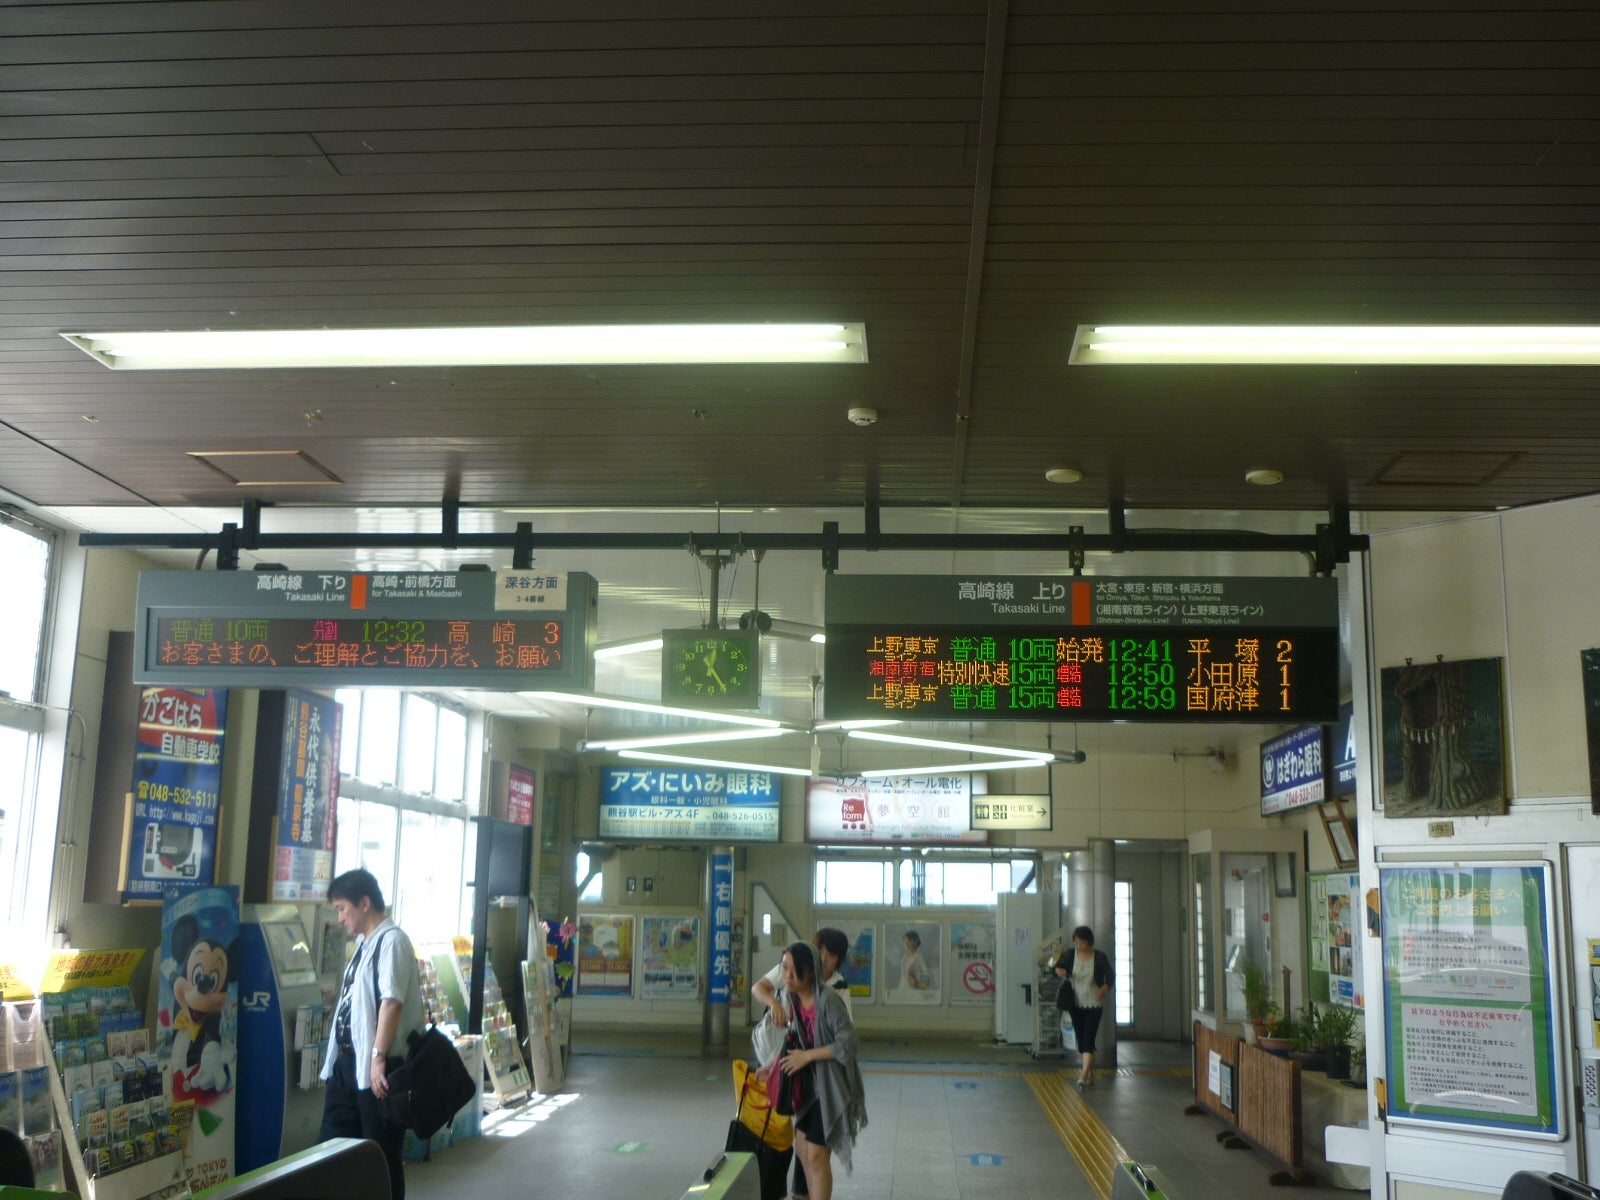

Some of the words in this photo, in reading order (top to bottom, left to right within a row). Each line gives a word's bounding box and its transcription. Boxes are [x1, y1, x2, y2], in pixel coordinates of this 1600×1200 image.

[257, 575, 302, 590] 高崎線
[318, 575, 346, 590] 下り
[372, 575, 456, 588] 高崎・前橋方面
[505, 576, 558, 589] 深谷方面
[1096, 583, 1224, 594] 大宮・東京・新宿・横浜方面
[285, 592, 324, 601] Takasaki
[326, 592, 345, 601] Line
[372, 590, 382, 598] for
[384, 590, 417, 598] Takasaki
[426, 590, 462, 598] Maebashi
[958, 582, 1014, 600] 高崎線
[1032, 582, 1066, 600] 上り
[991, 603, 1039, 614] Takasaki
[1043, 603, 1065, 614] Line
[171, 620, 214, 642] 普通
[225, 620, 269, 642] 10両
[362, 620, 425, 642] 12:32
[544, 622, 559, 644] 3
[162, 641, 277, 666] お客さまの、
[294, 642, 479, 667] ご理解とご協力を、
[866, 636, 939, 654] 上野東京
[950, 636, 996, 662] 普通
[1008, 638, 1056, 662] 10両
[1056, 637, 1104, 663] 始発
[1108, 639, 1172, 662] 12:41
[1276, 640, 1292, 662] 2
[870, 660, 936, 676] 湘南新宿
[938, 660, 1011, 685] 特別快速
[1008, 662, 1056, 685] 15両
[1108, 662, 1175, 686] 12:50
[1187, 662, 1259, 687] 小田原
[1280, 664, 1290, 686] 1
[866, 684, 939, 702] 上野東京
[950, 684, 996, 710] 普通
[1008, 686, 1056, 710] 15両
[1108, 686, 1176, 710] 12:59
[1187, 686, 1259, 712] 国府津
[1280, 688, 1290, 710] 1
[143, 692, 202, 732] かごはら
[162, 732, 220, 764] 自動車学校
[1276, 739, 1322, 784] はぎわら眼科
[301, 706, 321, 843] 永代供養墓
[836, 776, 962, 789] リフォーム・オール電化
[610, 772, 772, 796] アズ・にいみ眼科
[150, 783, 217, 808] 048-532-5111
[608, 808, 683, 818] 熊谷駅ビル・アズ
[686, 809, 700, 818] 4F
[712, 811, 774, 820] 048-526-0515
[843, 803, 854, 812] Re
[843, 812, 862, 820] form
[714, 882, 731, 976] 右側優先
[242, 992, 271, 1006] JR
